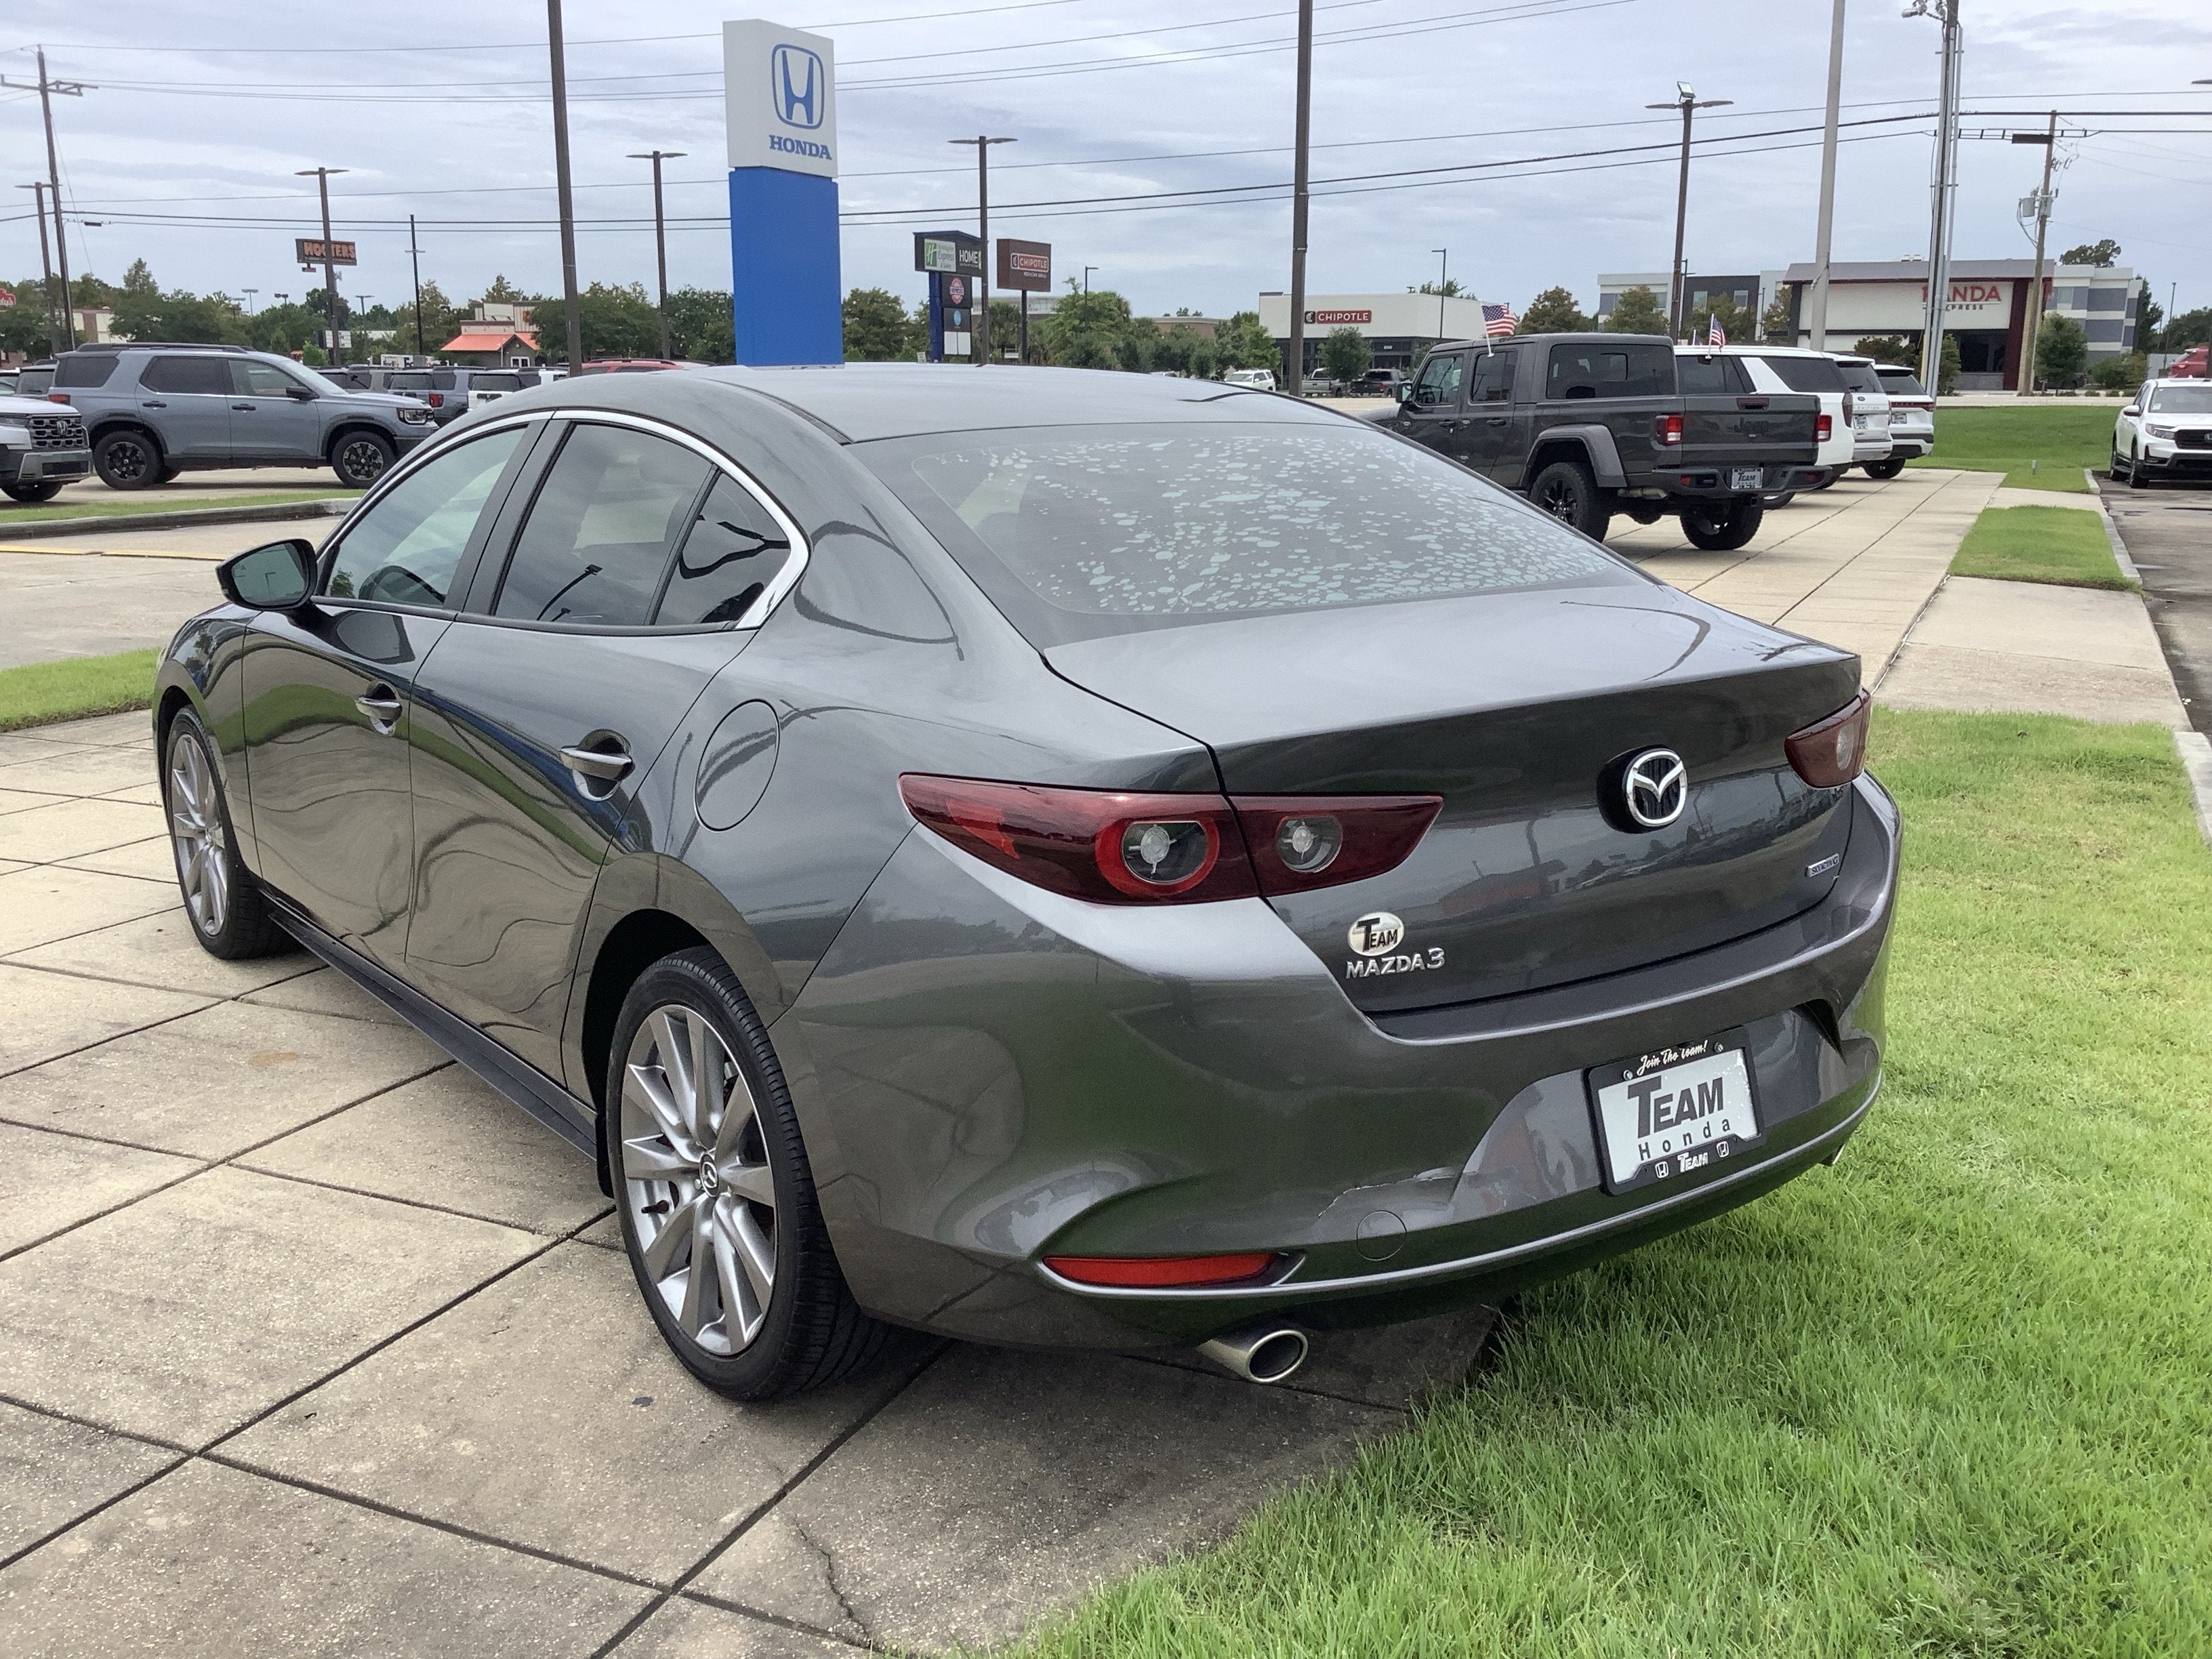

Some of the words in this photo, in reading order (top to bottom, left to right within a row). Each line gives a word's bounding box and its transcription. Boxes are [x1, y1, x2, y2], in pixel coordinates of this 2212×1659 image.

[769, 134, 832, 160] HONDA
[1019, 258, 1047, 268] CHIPOTLE
[1922, 285, 2002, 302] NDA
[1318, 312, 1369, 321] CHIPOTLE
[1738, 472, 1756, 481] TEAM
[1356, 917, 1398, 953] TEAM
[1637, 1054, 1661, 1076] Join
[1660, 1048, 1679, 1065] The
[1627, 1075, 1724, 1139] TEAM
[1638, 1118, 1730, 1161] Honda
[1677, 1152, 1708, 1172] TEAM
